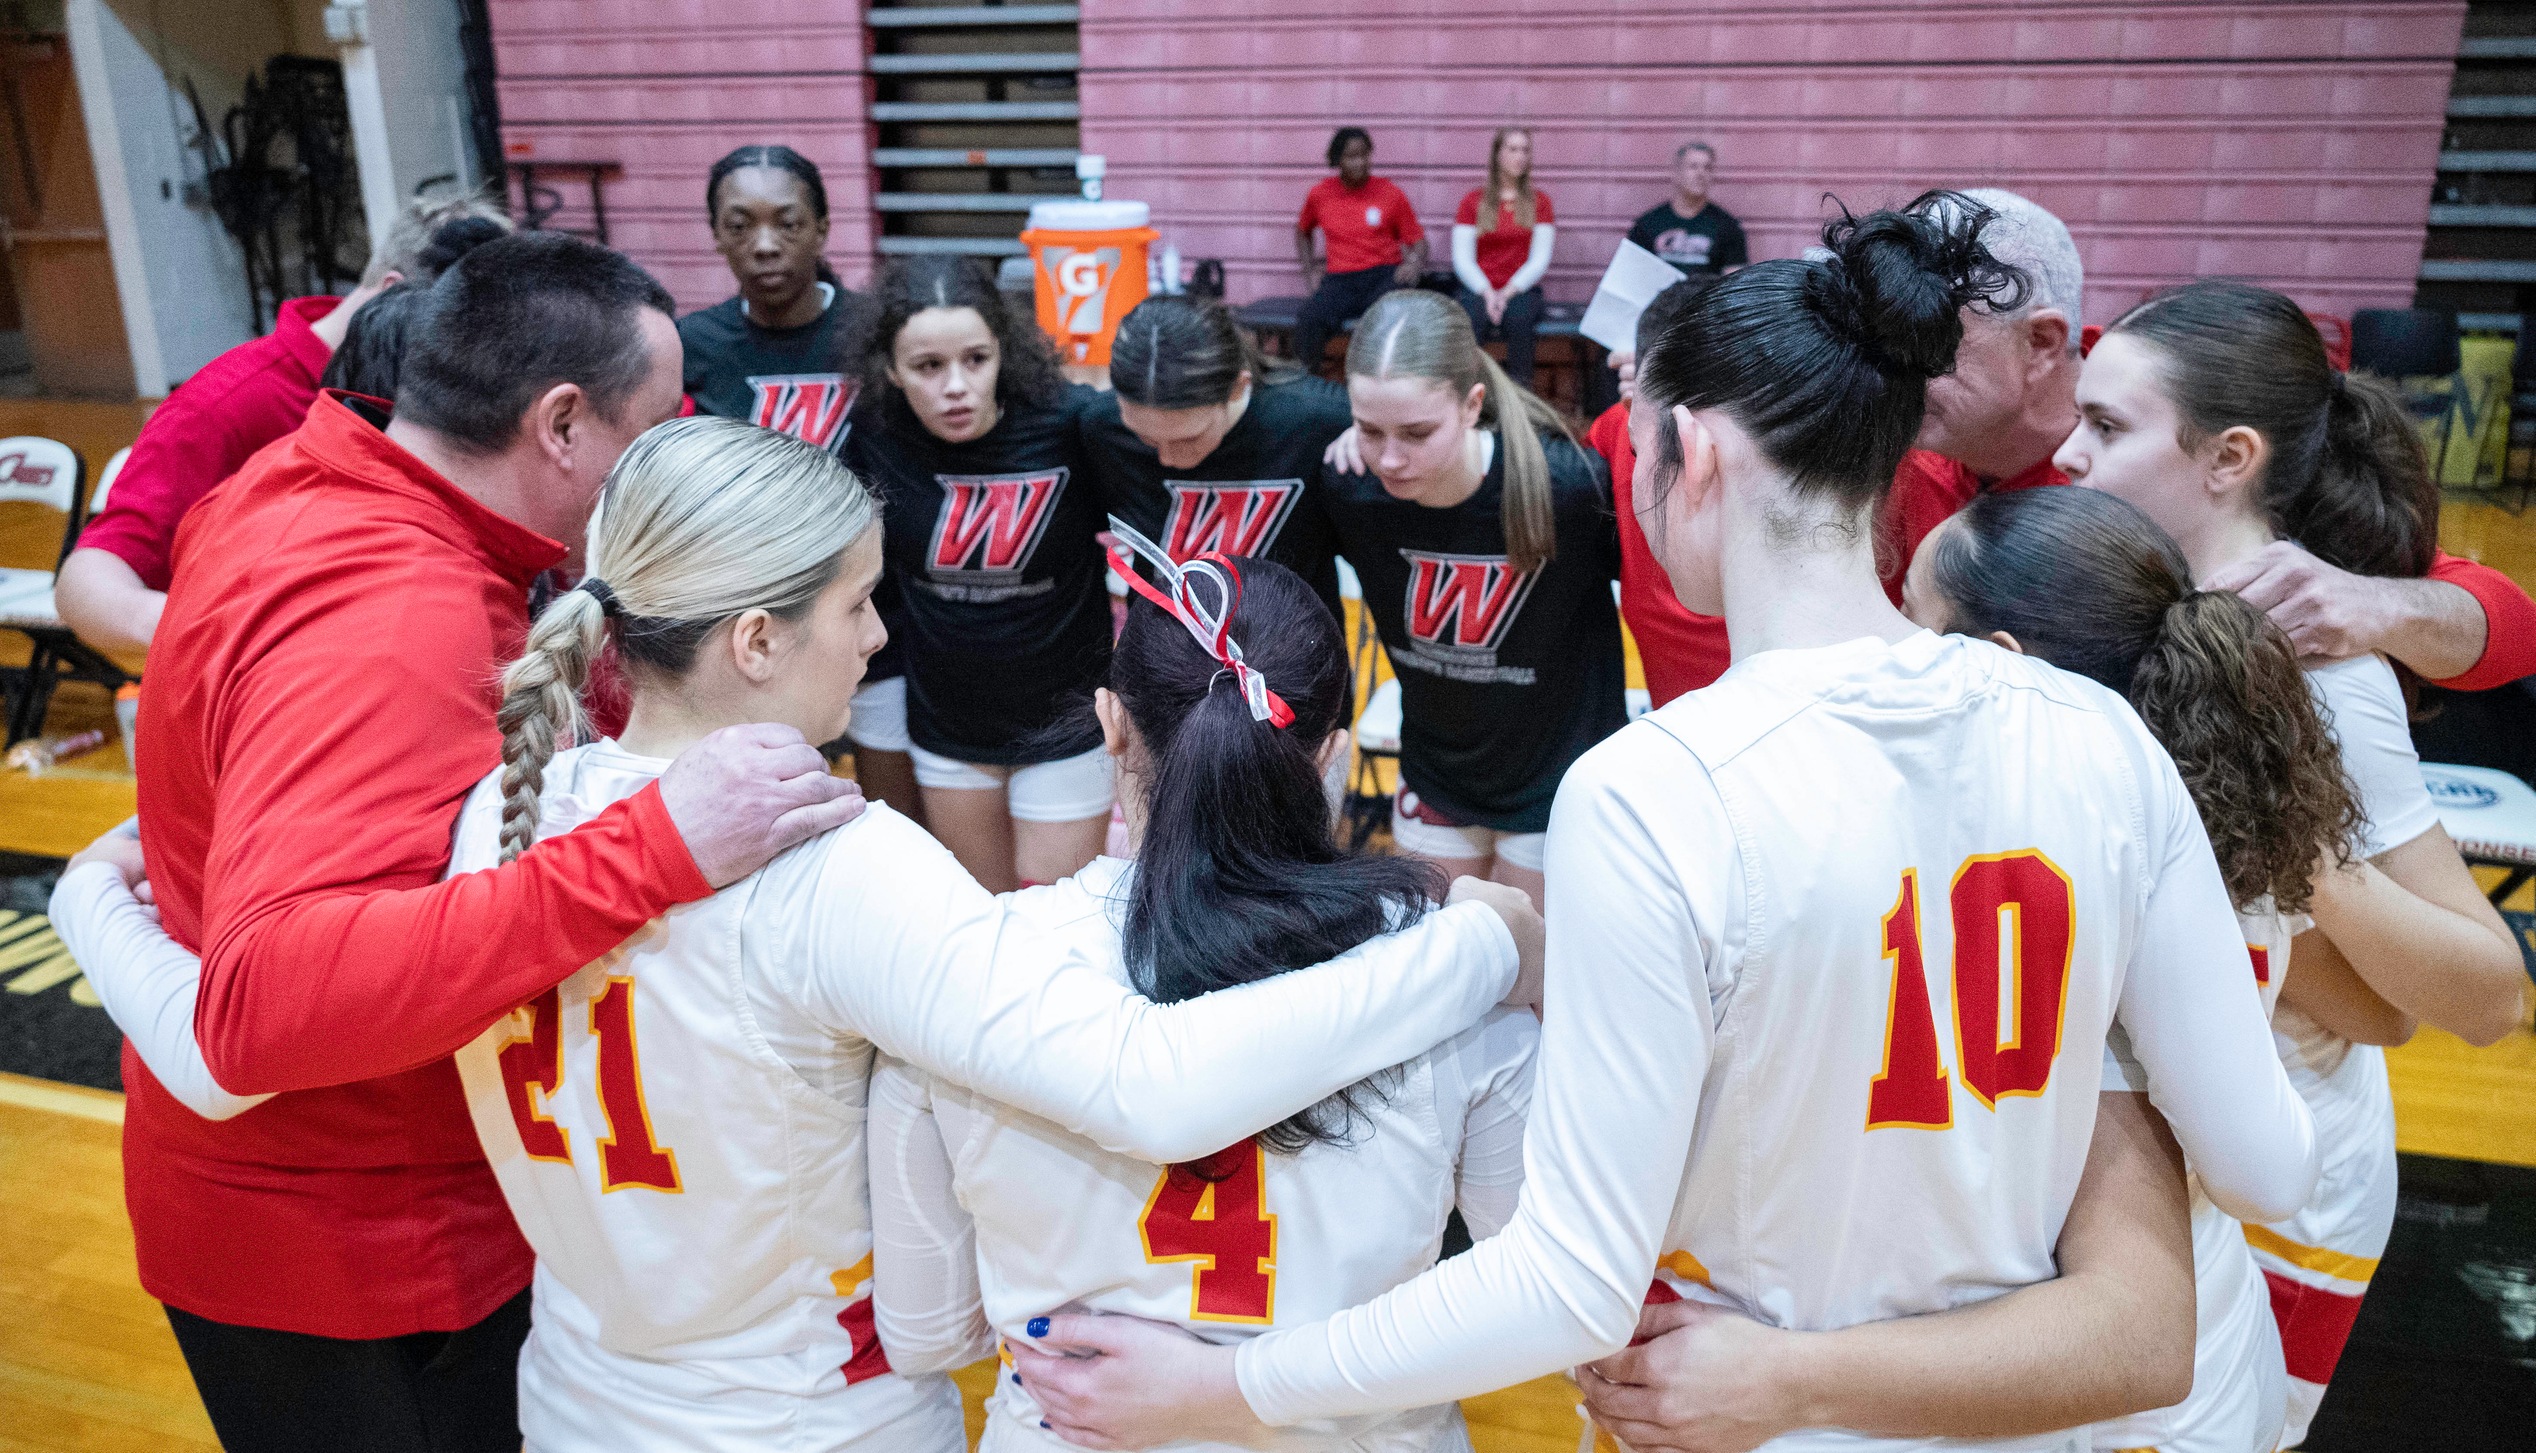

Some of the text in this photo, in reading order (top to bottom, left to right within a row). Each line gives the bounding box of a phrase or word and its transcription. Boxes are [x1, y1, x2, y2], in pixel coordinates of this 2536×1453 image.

[1060, 253, 1100, 296] G
[746, 373, 861, 456] W
[926, 466, 1070, 572] W
[1156, 479, 1304, 575] W
[1399, 548, 1546, 651] W
[1864, 847, 2076, 1133] 10
[497, 975, 685, 1194] 21
[1137, 1136, 1278, 1325] 4
